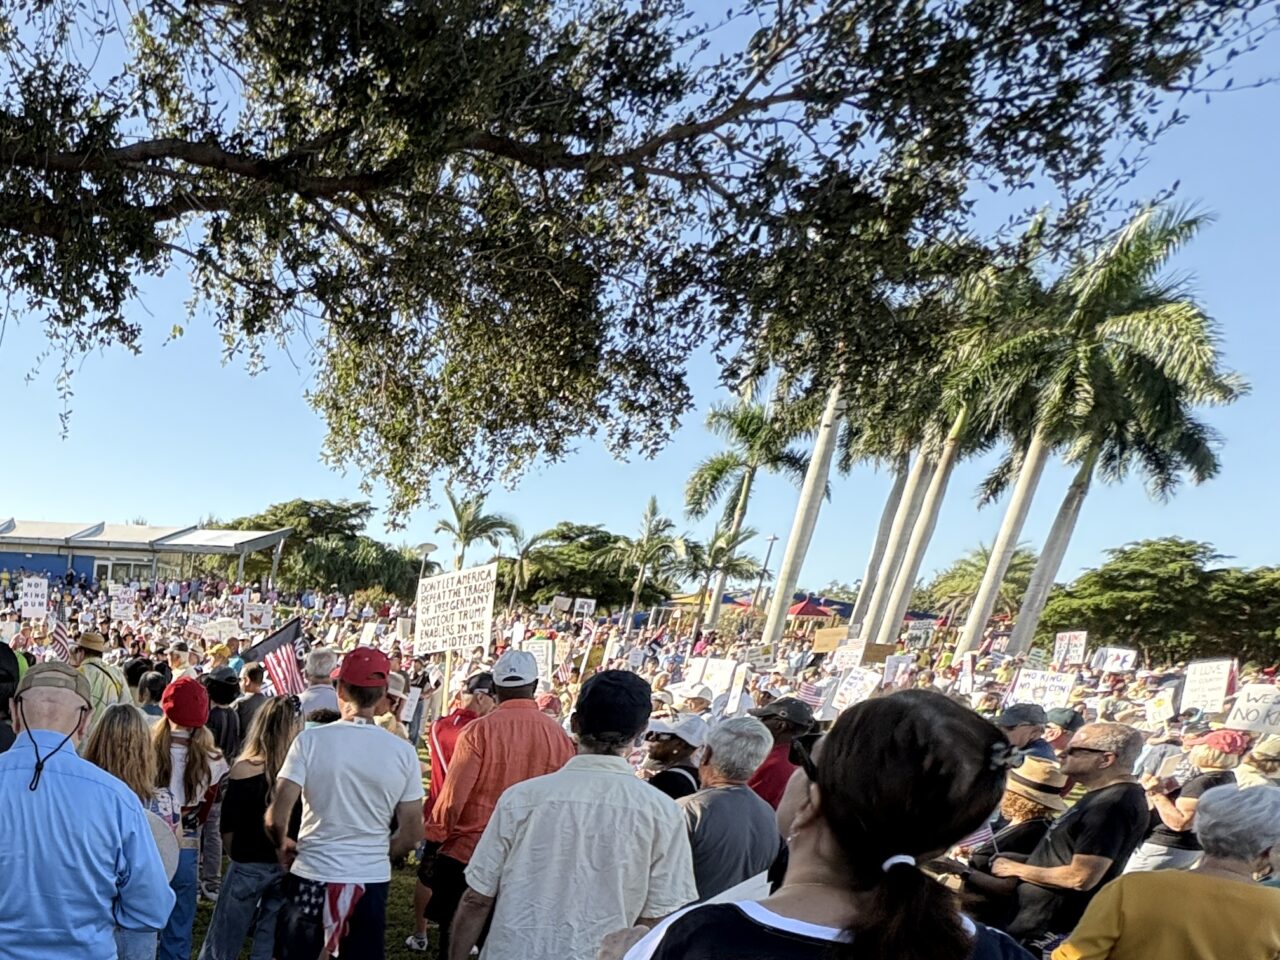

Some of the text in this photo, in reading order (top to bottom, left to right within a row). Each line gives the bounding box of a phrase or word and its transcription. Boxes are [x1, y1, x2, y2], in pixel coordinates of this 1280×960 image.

[442, 576, 455, 589] LET
[456, 569, 492, 586] AMERICA
[23, 591, 46, 599] KING
[421, 580, 496, 605] REPEAT THE TRAGEDY
[421, 605, 430, 615] OF
[450, 593, 490, 610] GERMANY
[441, 612, 455, 625] OUT
[458, 607, 487, 621] TRUMP
[420, 619, 484, 640] ENABLERS IN THE
[442, 632, 484, 648] MIDTERMS
[1018, 681, 1031, 690] NO
[1232, 707, 1261, 722] NO
